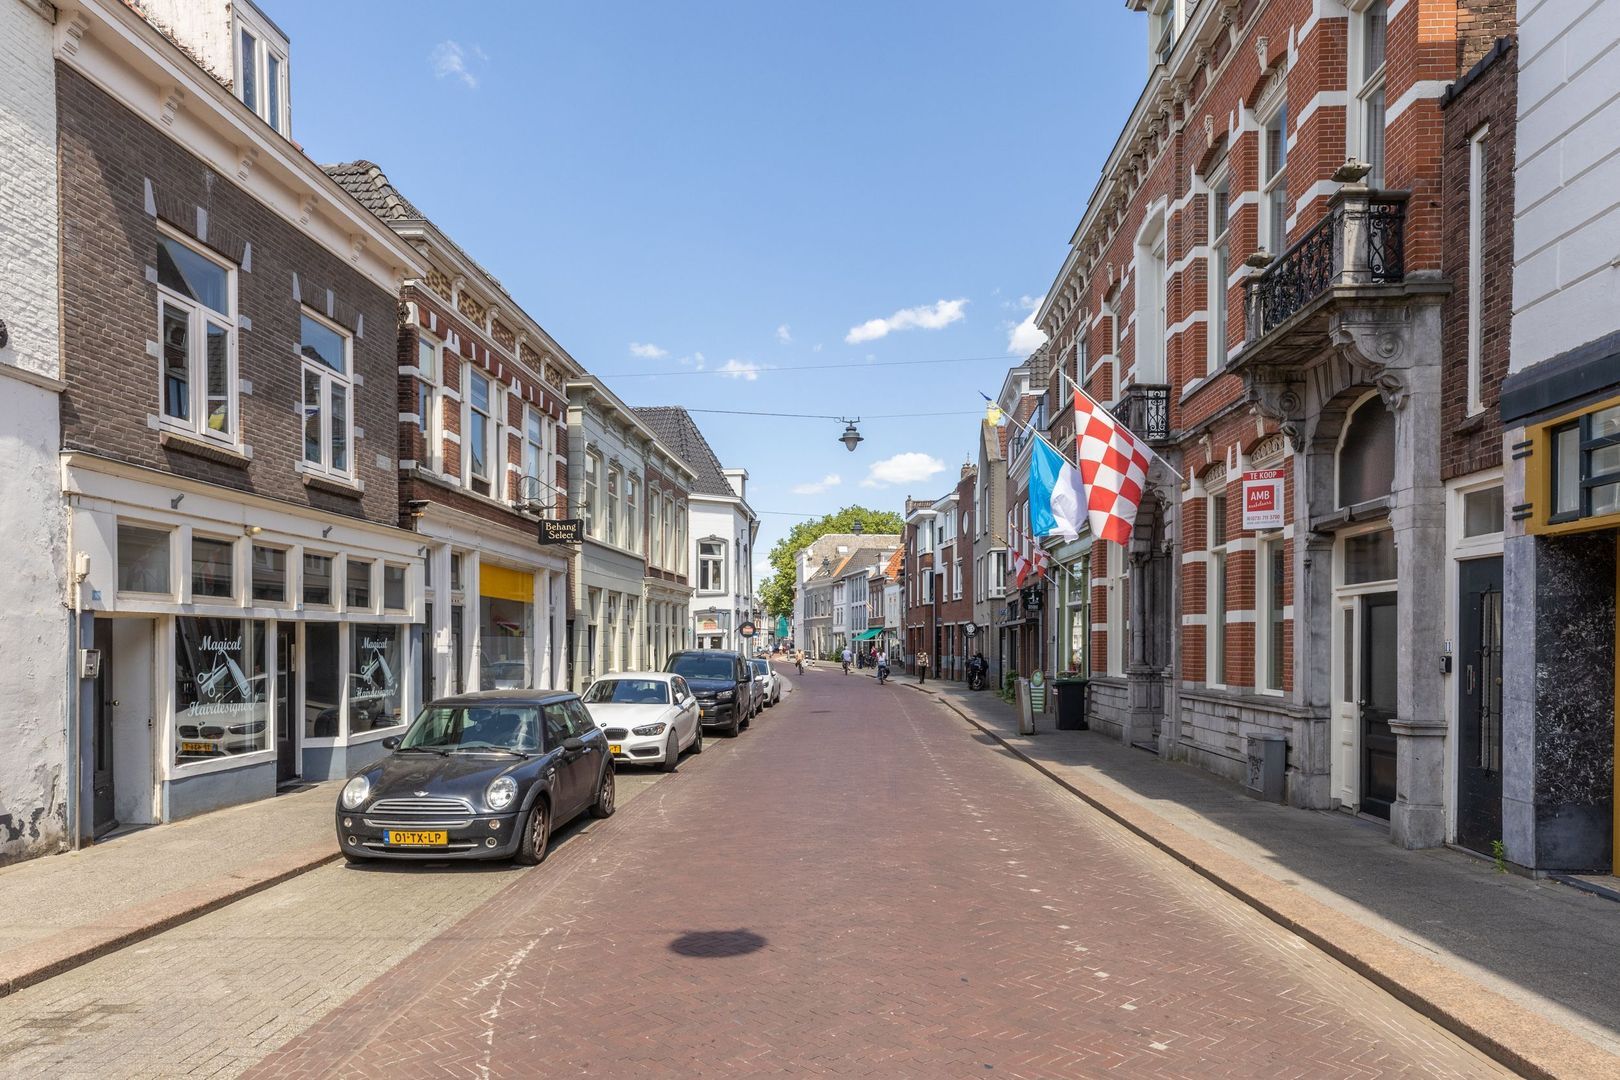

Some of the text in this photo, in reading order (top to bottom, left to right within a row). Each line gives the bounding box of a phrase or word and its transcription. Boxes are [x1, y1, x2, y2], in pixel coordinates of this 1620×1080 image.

[1250, 471, 1277, 480] TE KOOP
[1250, 490, 1270, 501] AMB
[545, 522, 577, 532] Behang
[548, 530, 574, 539] Select
[199, 635, 242, 655] Magical
[361, 637, 388, 652] Magical
[187, 700, 256, 717] Hairdesigner
[394, 832, 442, 844] 01-TX-LP
